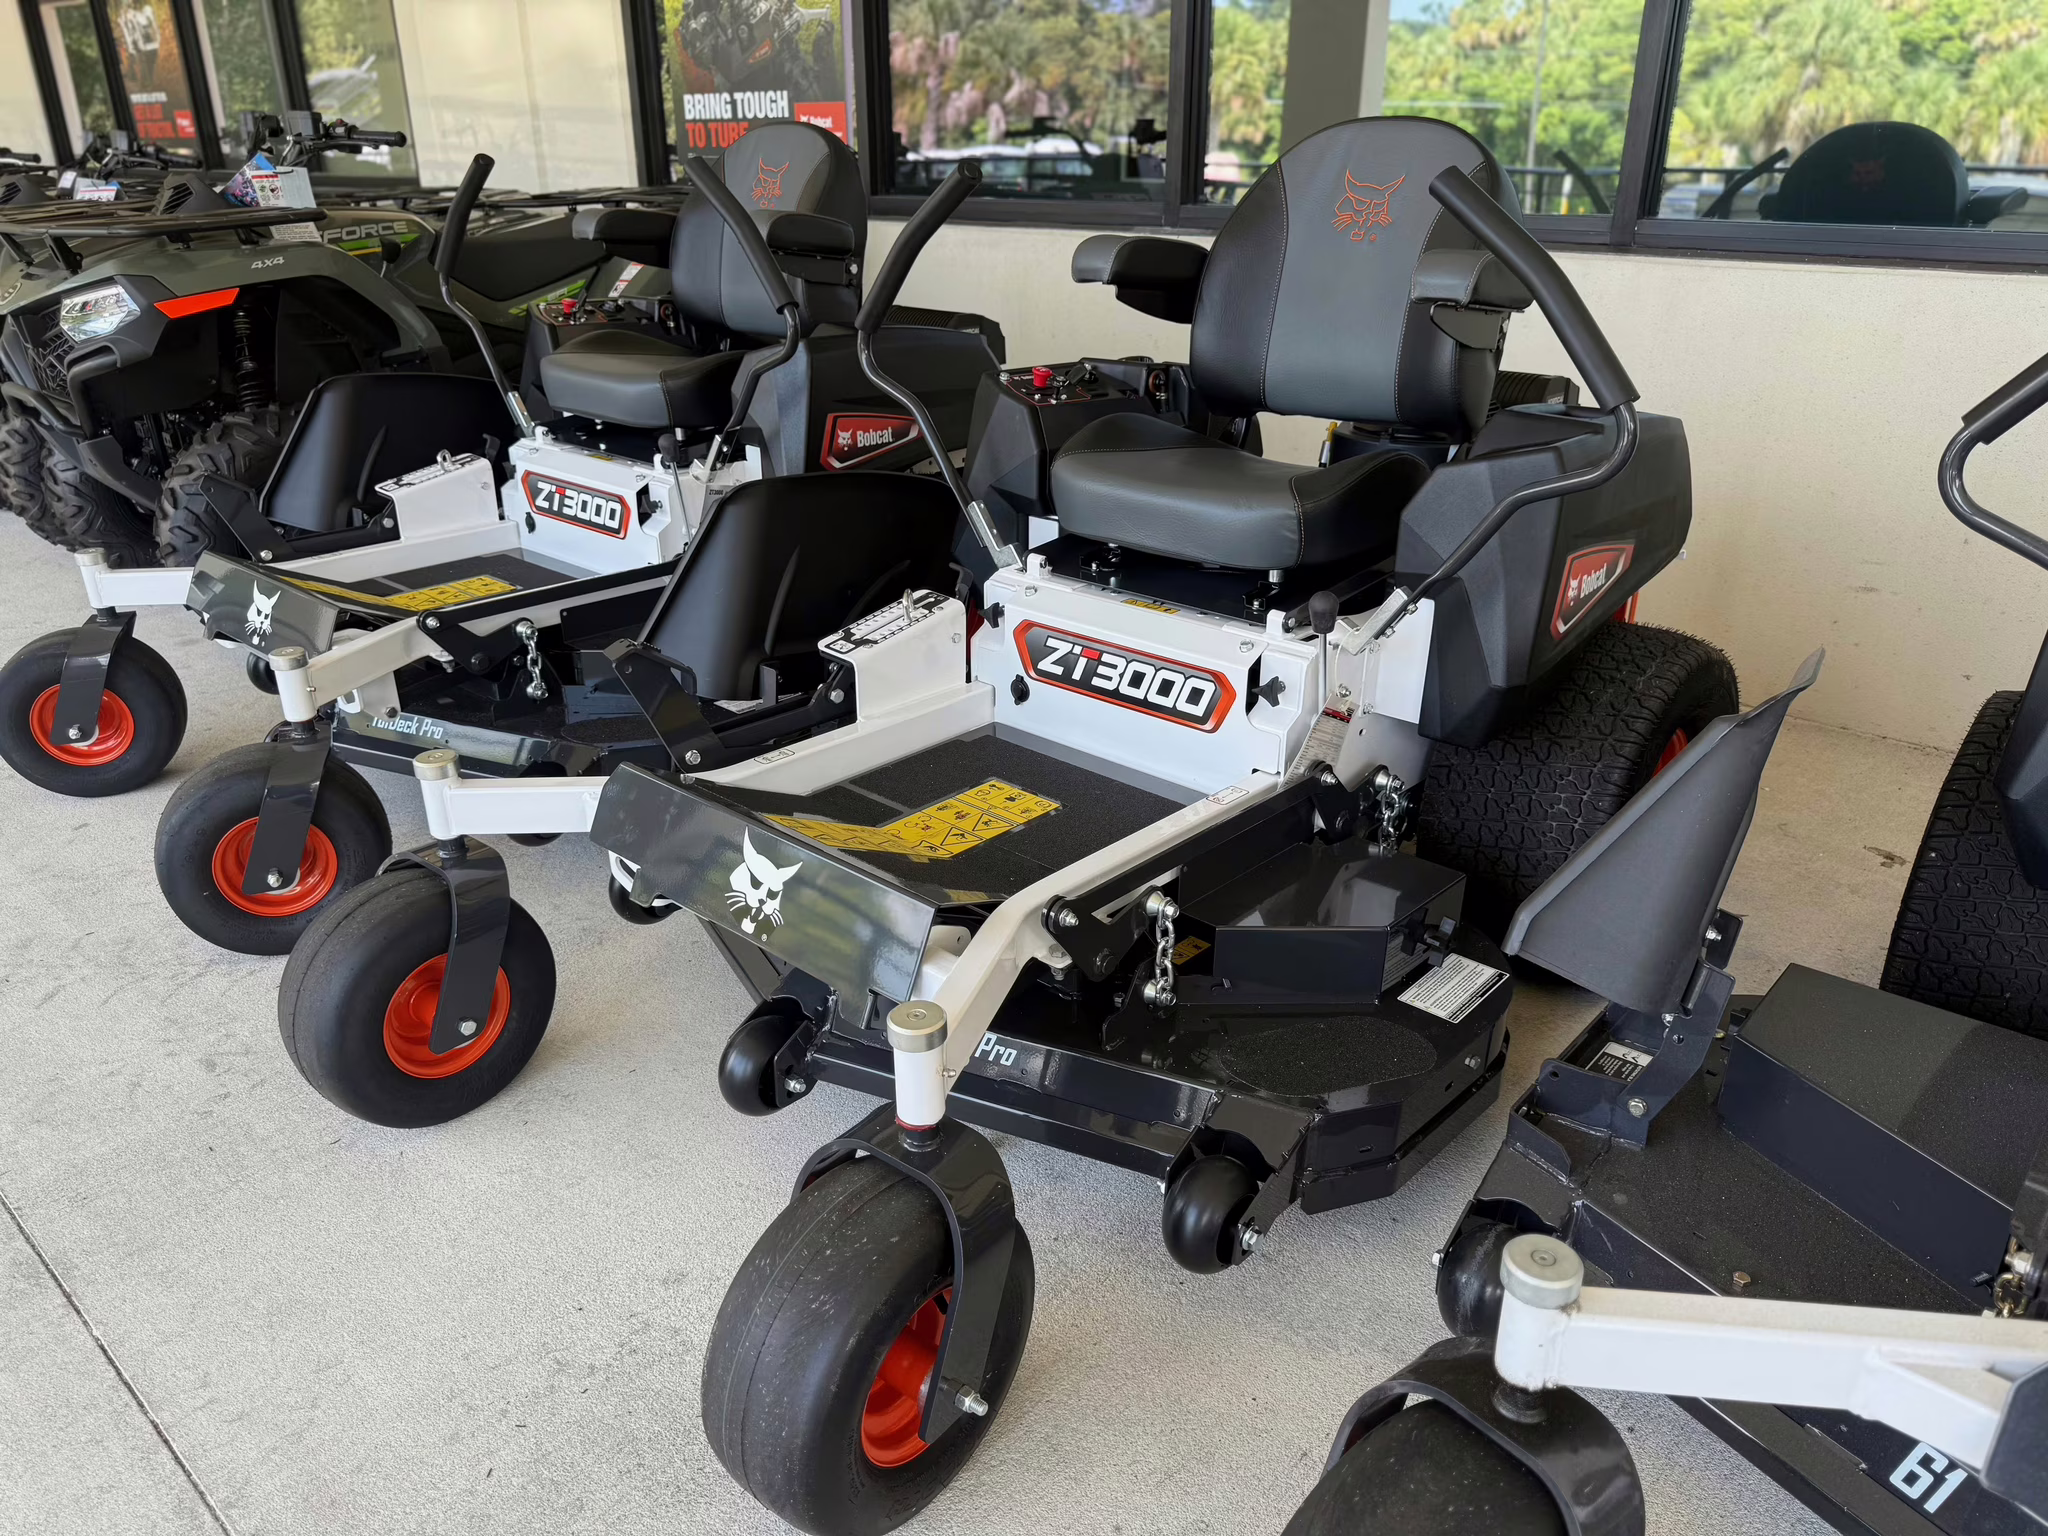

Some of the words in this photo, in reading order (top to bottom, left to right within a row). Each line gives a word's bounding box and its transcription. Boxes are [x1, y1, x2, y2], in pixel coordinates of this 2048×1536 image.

[683, 93, 732, 120] BRING
[733, 90, 789, 119] TOUGH
[685, 121, 707, 148] TO
[319, 221, 408, 243] FORCE
[856, 426, 893, 448] Bobcat
[535, 481, 622, 529] ZT3000
[1580, 562, 1607, 599] Bobcat
[1036, 637, 1217, 717] ZT3000
[419, 718, 444, 739] Pro
[974, 1032, 1018, 1066] Pro
[1889, 1441, 1969, 1513] 61
